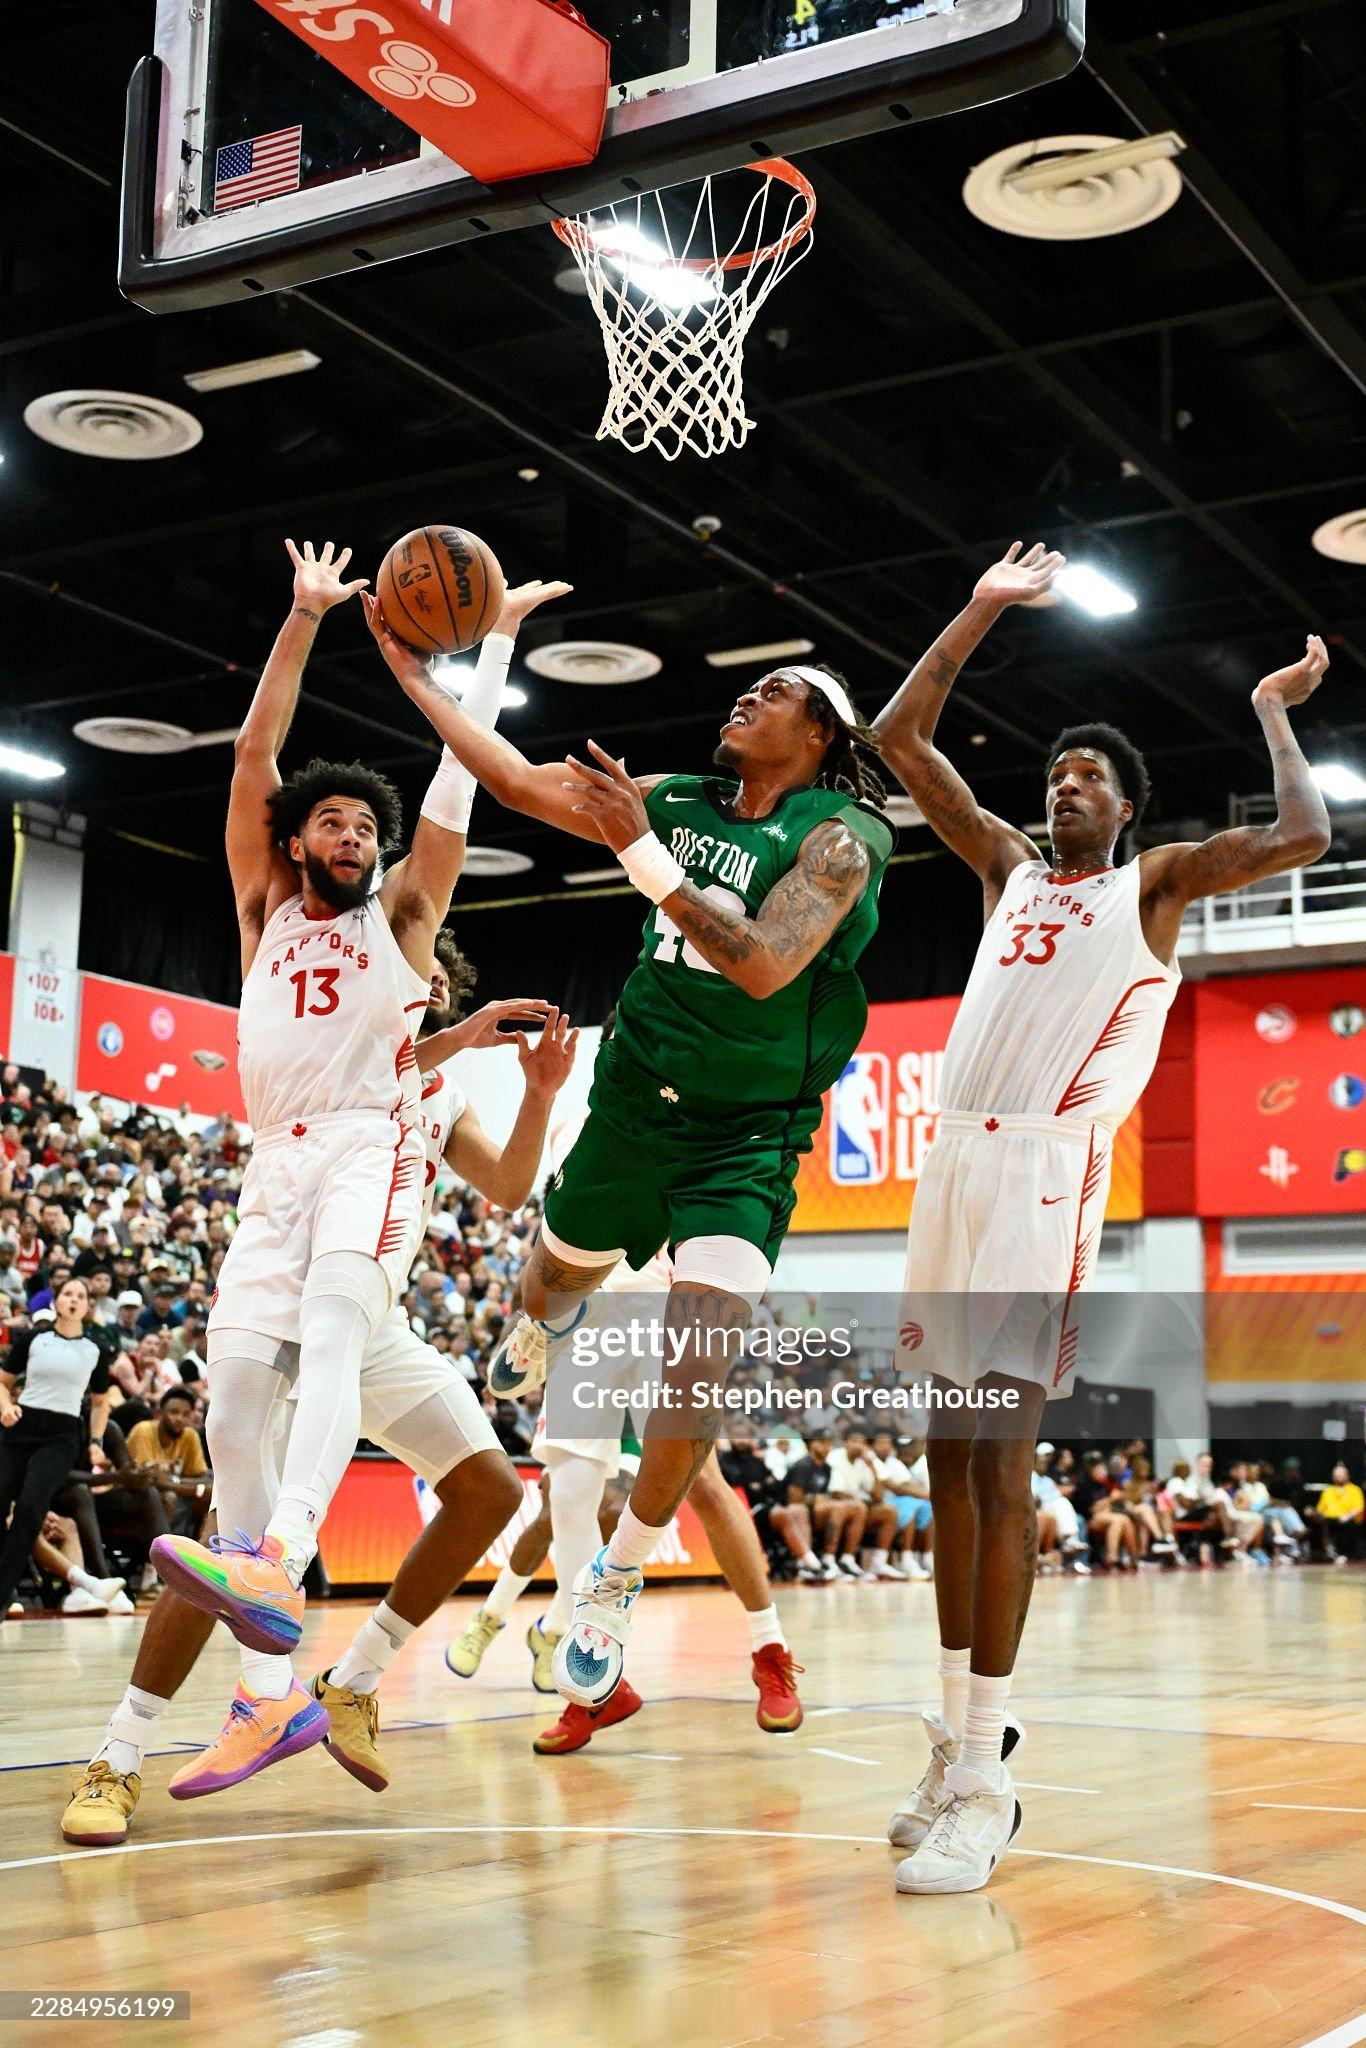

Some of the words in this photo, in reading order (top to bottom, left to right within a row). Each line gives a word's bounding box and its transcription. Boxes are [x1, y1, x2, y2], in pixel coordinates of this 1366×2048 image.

[999, 922, 1066, 967] 33
[36, 972, 60, 992] 107
[289, 968, 340, 1018] 13
[34, 1000, 58, 1022] 108
